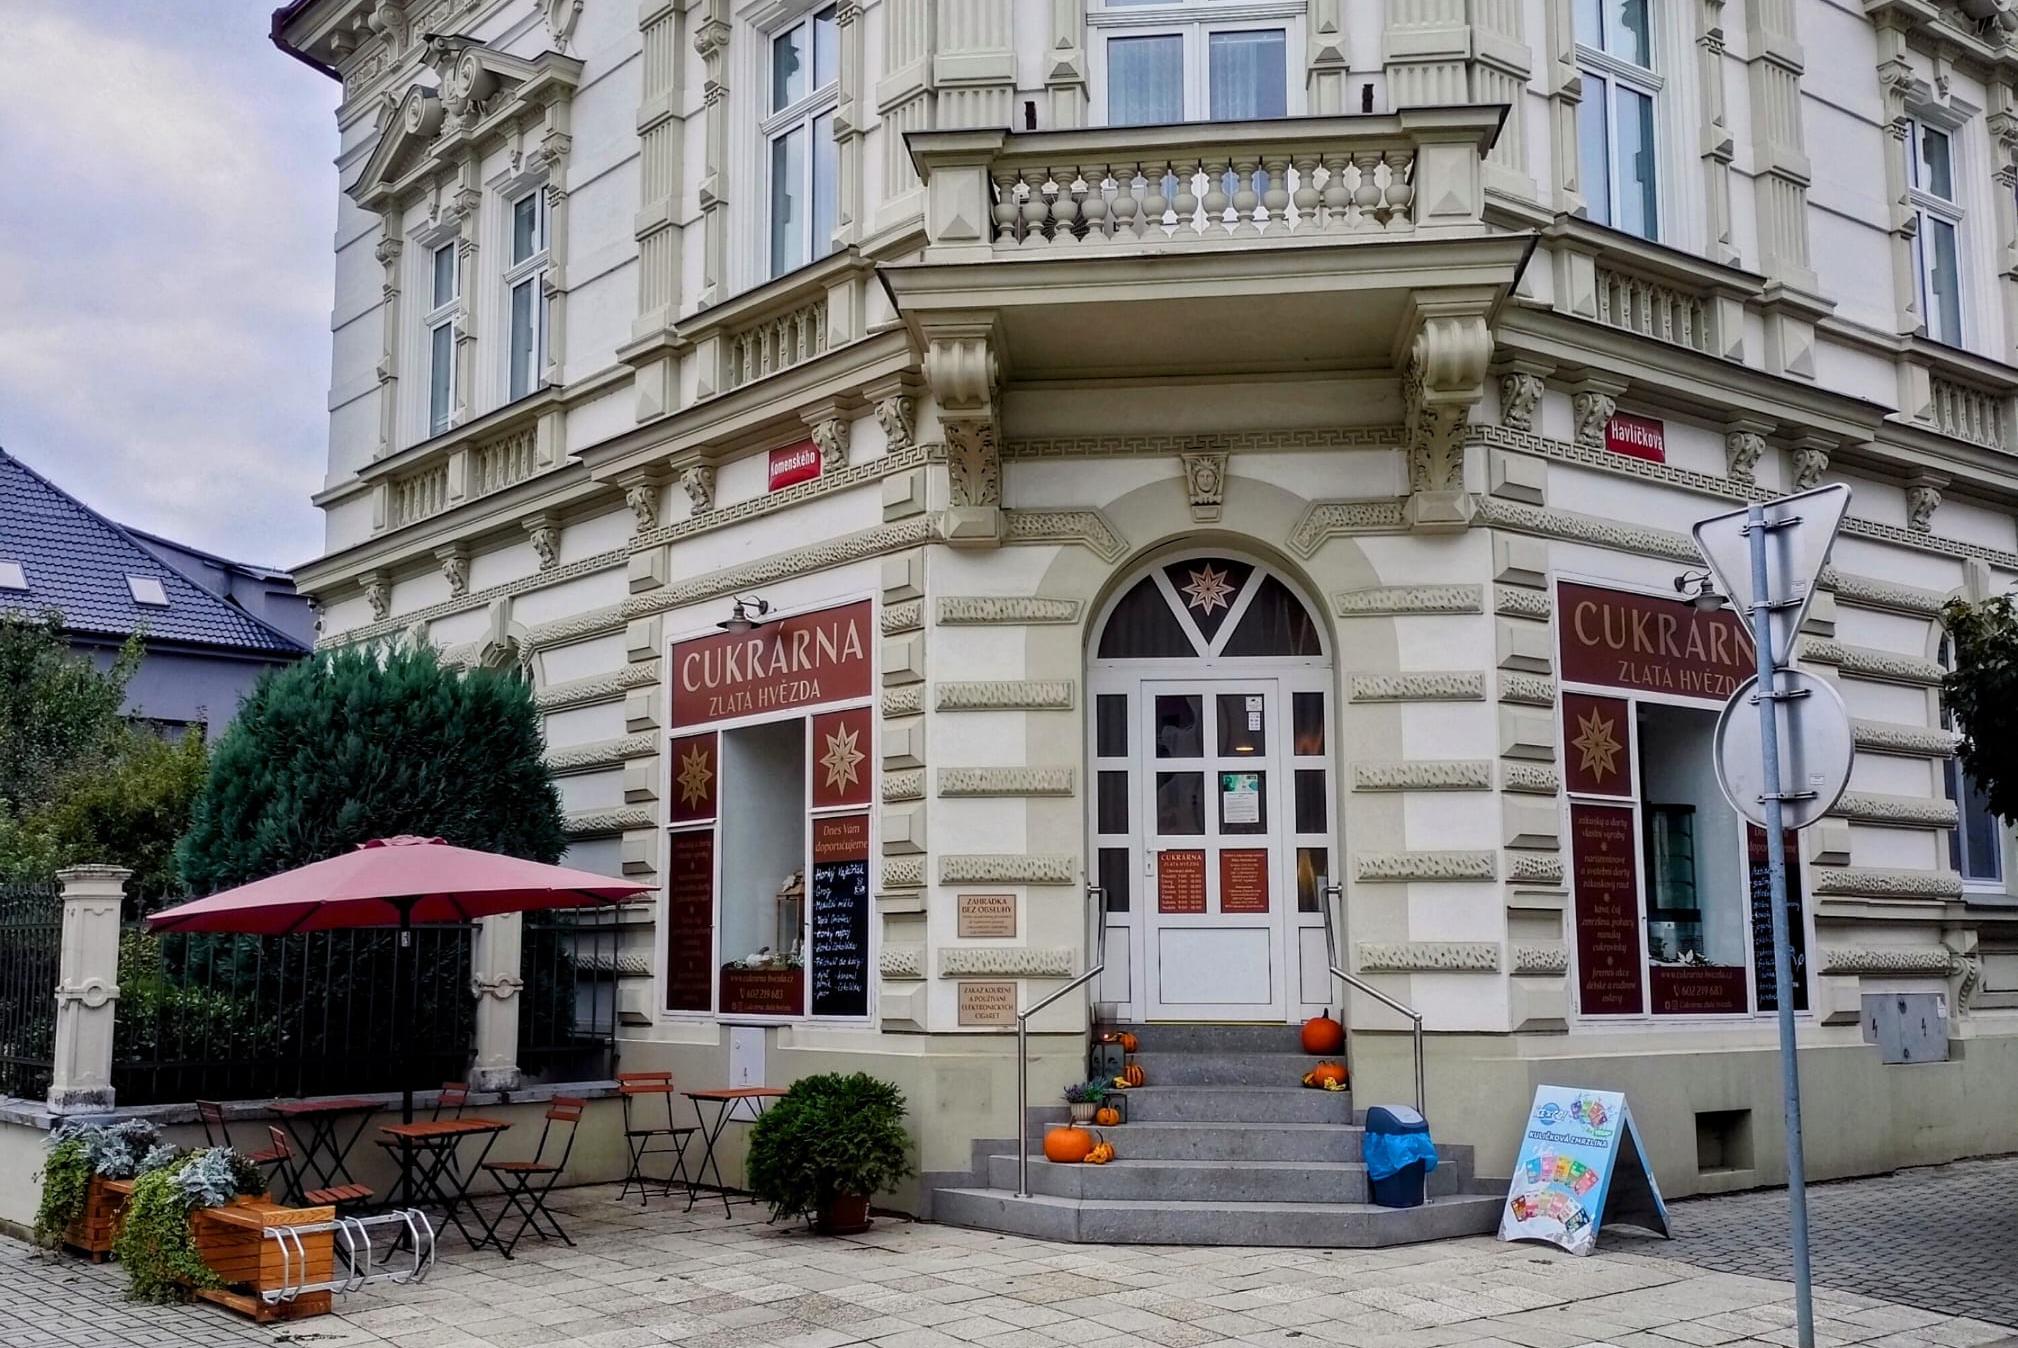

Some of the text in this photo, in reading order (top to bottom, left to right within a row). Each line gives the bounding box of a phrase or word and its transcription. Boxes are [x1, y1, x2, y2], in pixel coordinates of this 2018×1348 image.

[1611, 419, 1663, 451] Havlíčkova
[770, 449, 815, 477] Komenského
[682, 618, 864, 692] CUKRÁRNA
[1618, 660, 1743, 696] ZLATÁ HVĚZD
[709, 678, 821, 717] ZLATÁ HVĚZDA
[1529, 1130, 1608, 1148] KULIČKOVÁ ZMRZLINA
